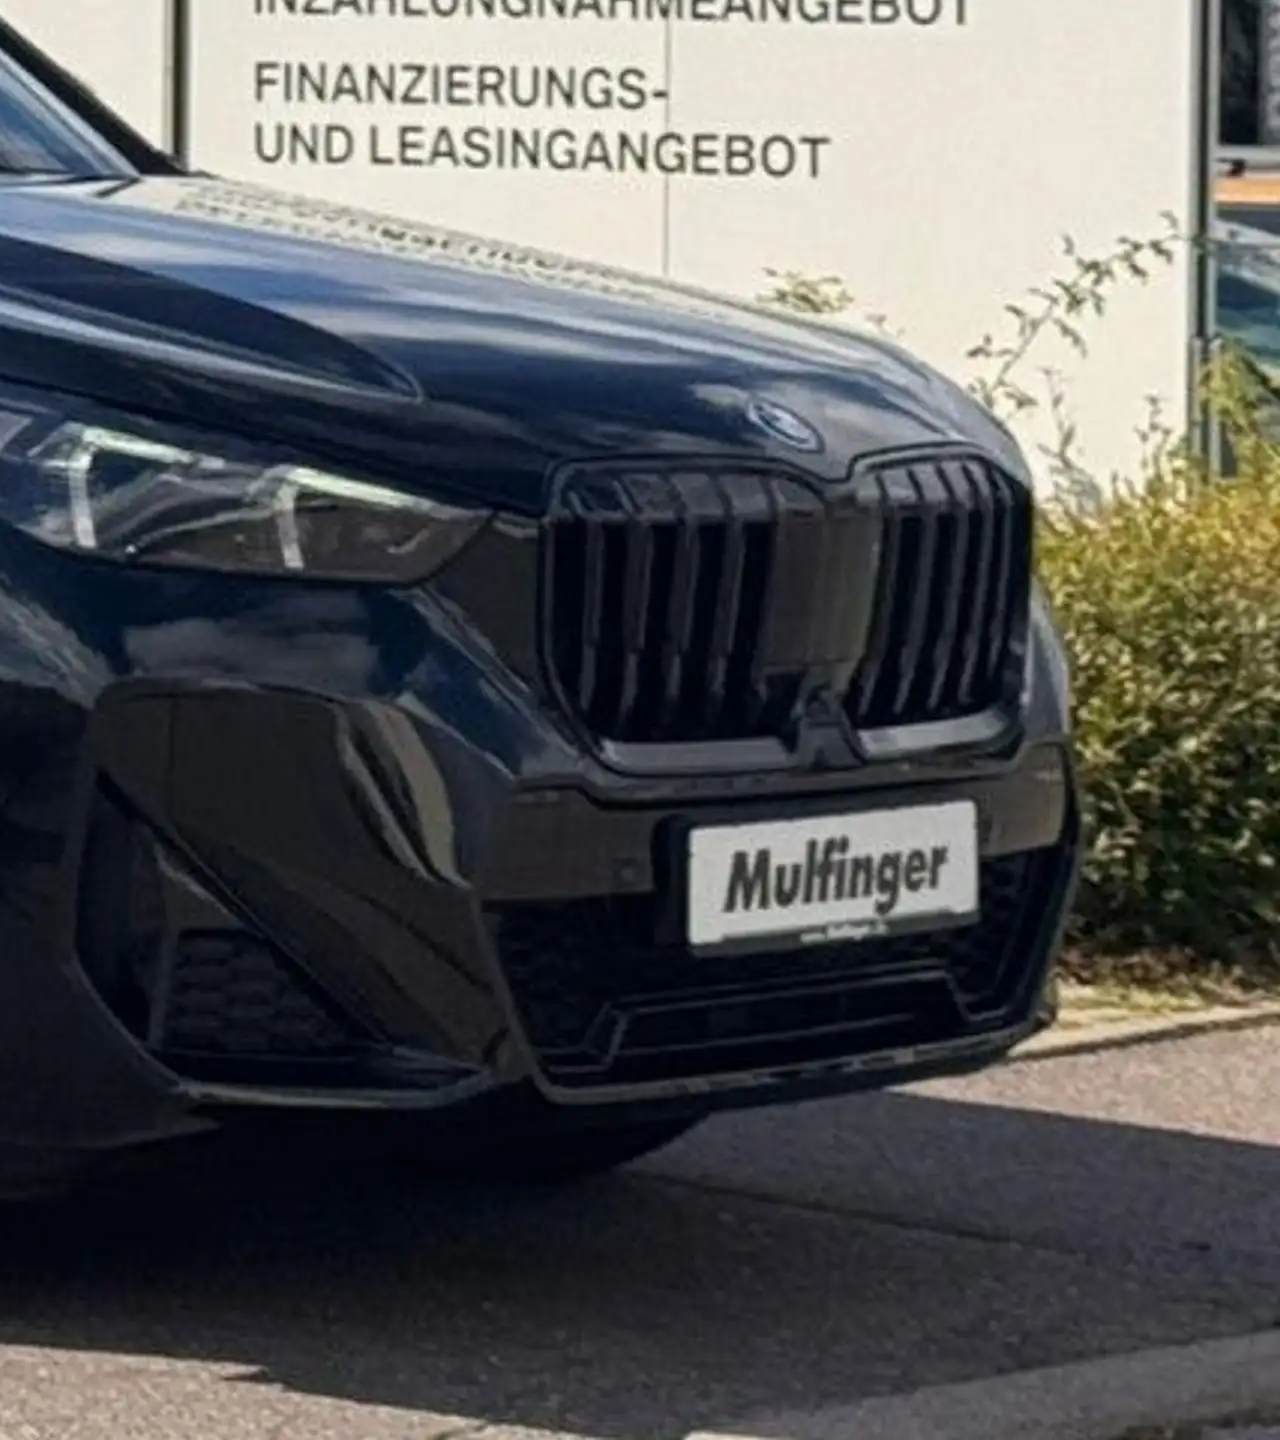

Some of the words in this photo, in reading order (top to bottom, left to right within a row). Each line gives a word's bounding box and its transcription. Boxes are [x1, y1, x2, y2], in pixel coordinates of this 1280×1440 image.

[254, 61, 670, 111] FINANZIERUNGS-
[254, 123, 354, 165] UND
[369, 124, 831, 179] LEASINGANGEBOT
[723, 835, 948, 915] Mulfinger
